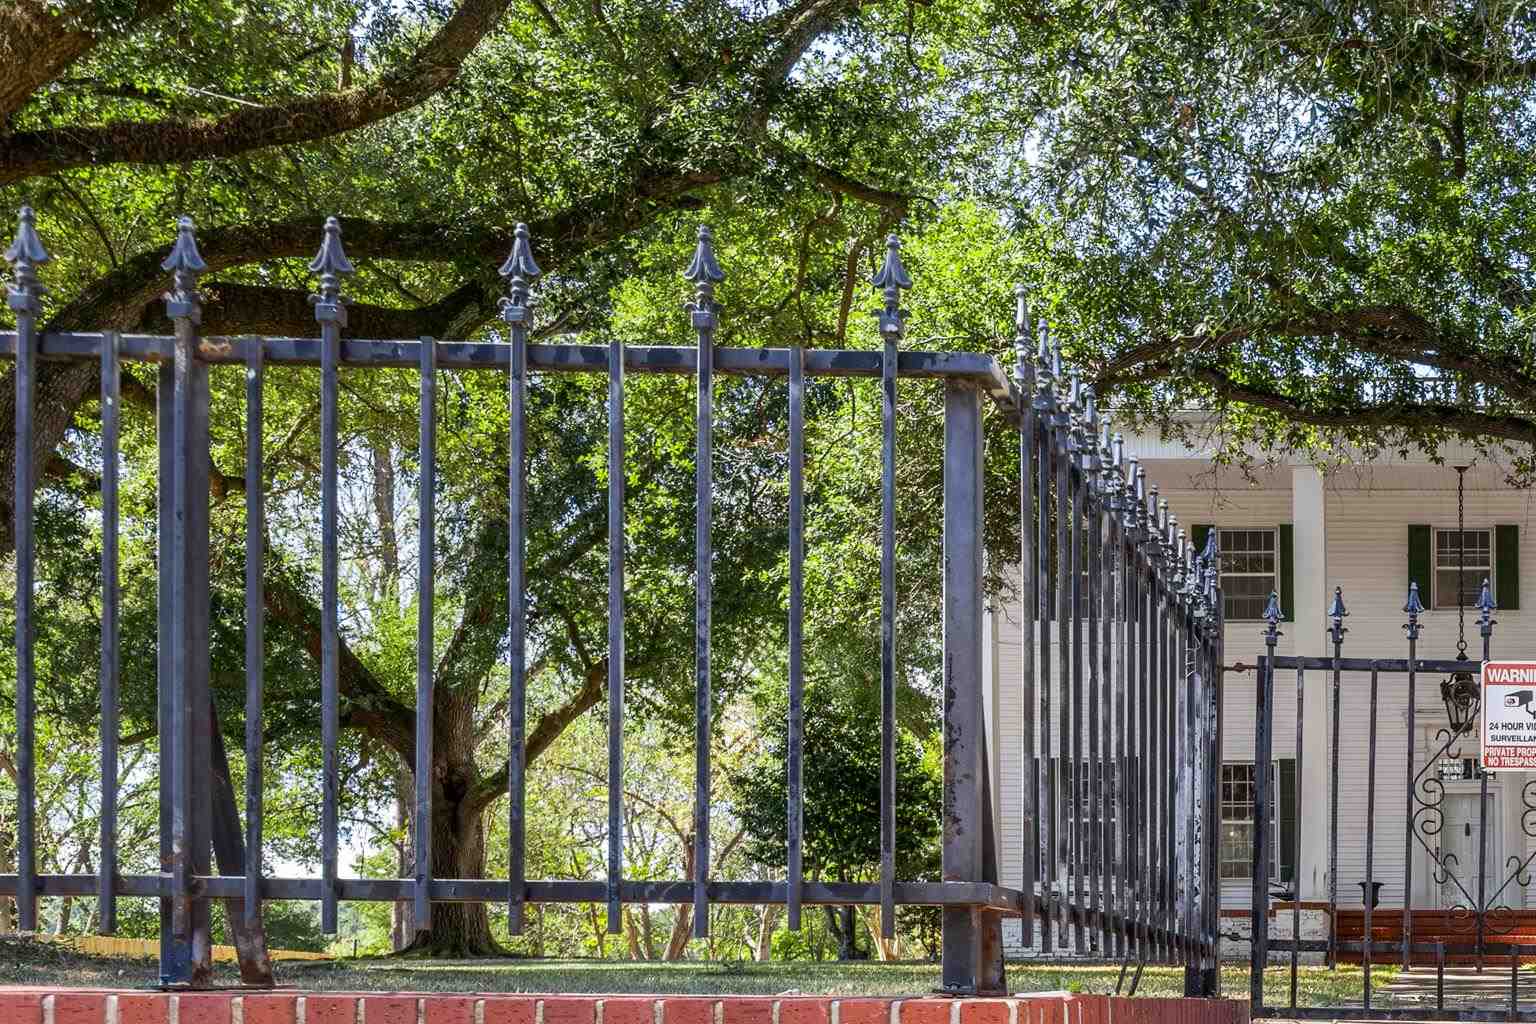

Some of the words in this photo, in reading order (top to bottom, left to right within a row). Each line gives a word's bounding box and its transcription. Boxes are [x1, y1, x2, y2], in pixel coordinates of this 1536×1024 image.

[1489, 722, 1499, 731] 24
[1502, 722, 1524, 731] HOUR
[1485, 747, 1515, 757] PRIVATE
[1488, 757, 1499, 766] NO
